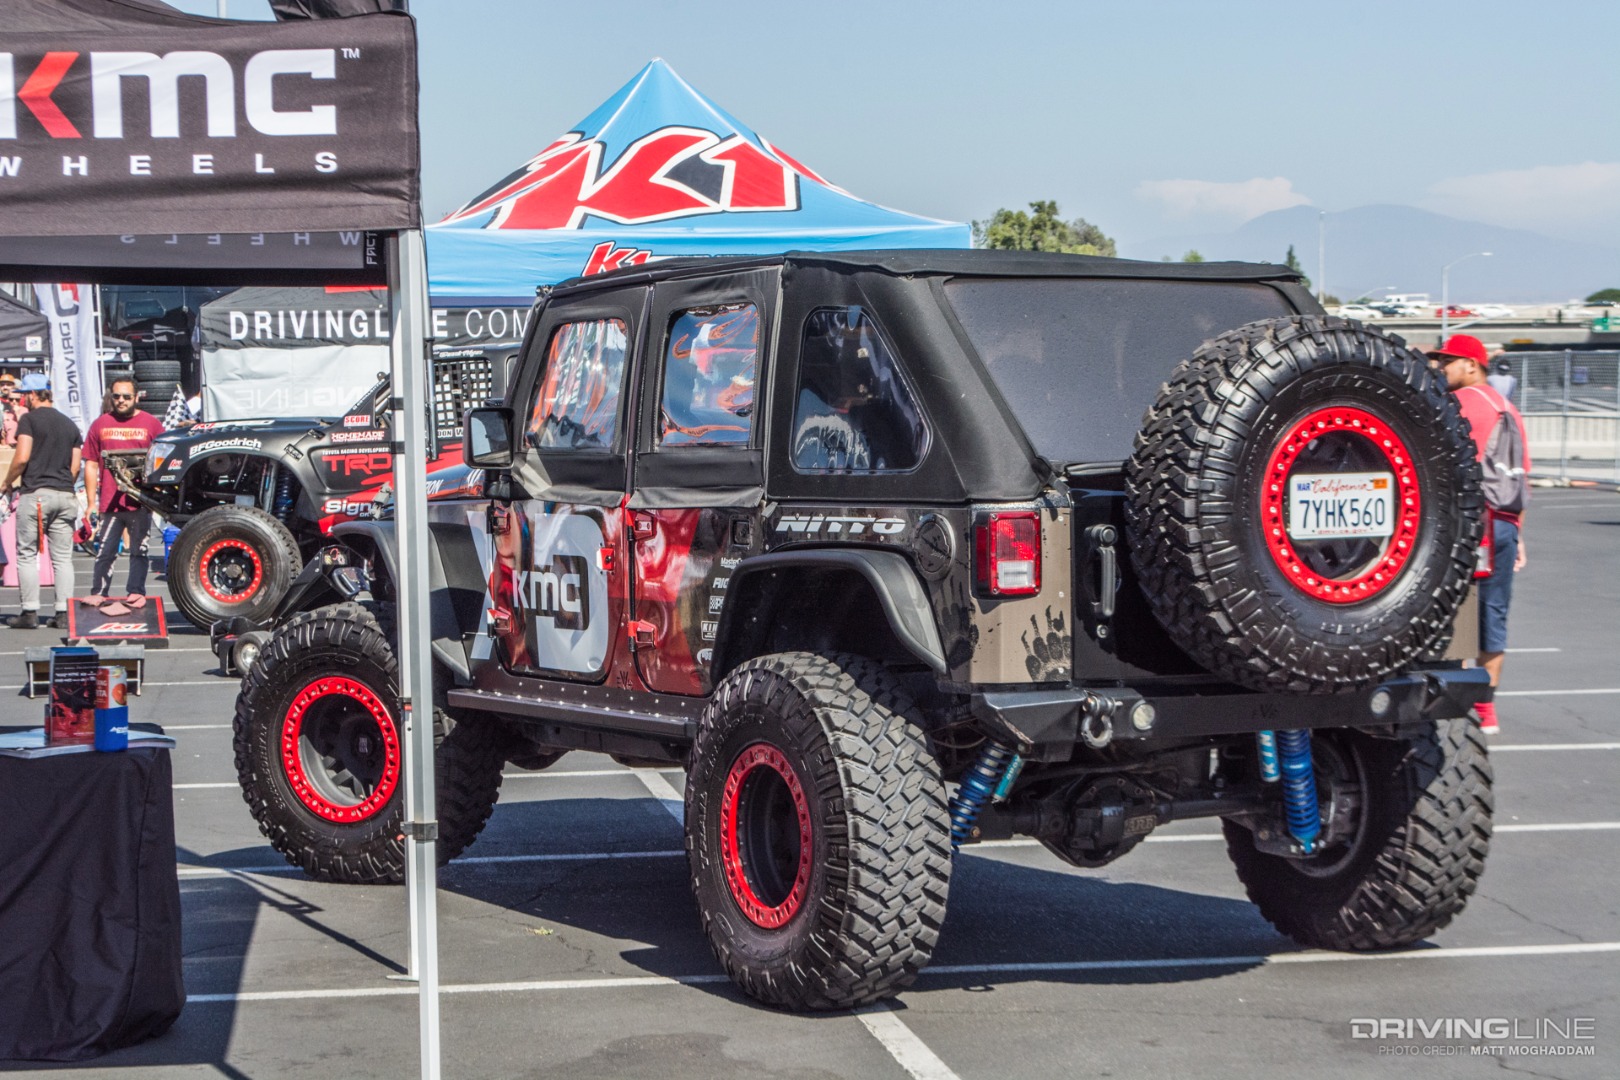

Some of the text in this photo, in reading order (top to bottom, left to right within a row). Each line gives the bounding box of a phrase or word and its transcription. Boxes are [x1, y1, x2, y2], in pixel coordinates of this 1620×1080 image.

[0, 152, 338, 177] WHEELS
[366, 231, 378, 265] FACT
[229, 308, 522, 341] DRIVINGLE.COM
[331, 431, 385, 440] HOMEMADE
[189, 438, 262, 456] BFGoodrich
[322, 453, 392, 476] TRD
[1296, 483, 1311, 491] MAR
[1312, 478, 1374, 497] California
[1299, 498, 1385, 529] 7YHK560
[774, 516, 907, 534] NITTO
